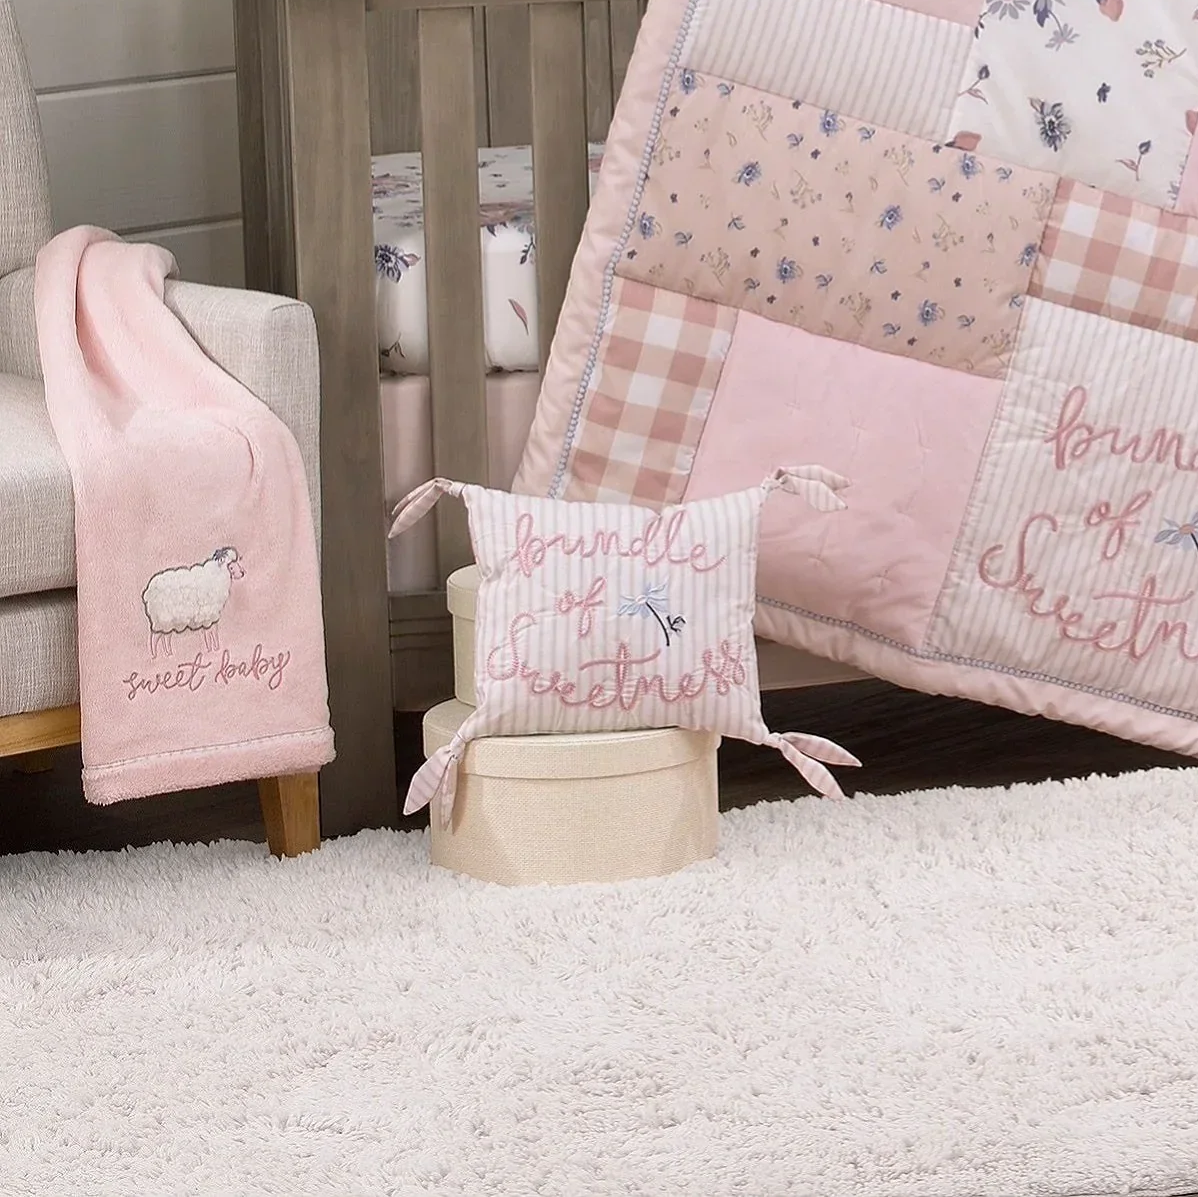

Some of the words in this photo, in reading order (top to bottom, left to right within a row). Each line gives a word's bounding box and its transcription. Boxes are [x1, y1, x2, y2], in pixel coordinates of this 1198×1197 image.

[509, 509, 727, 578] bundle
[1085, 491, 1153, 560] of
[556, 576, 606, 638] of
[122, 652, 212, 701] sweet
[214, 643, 291, 691] baby
